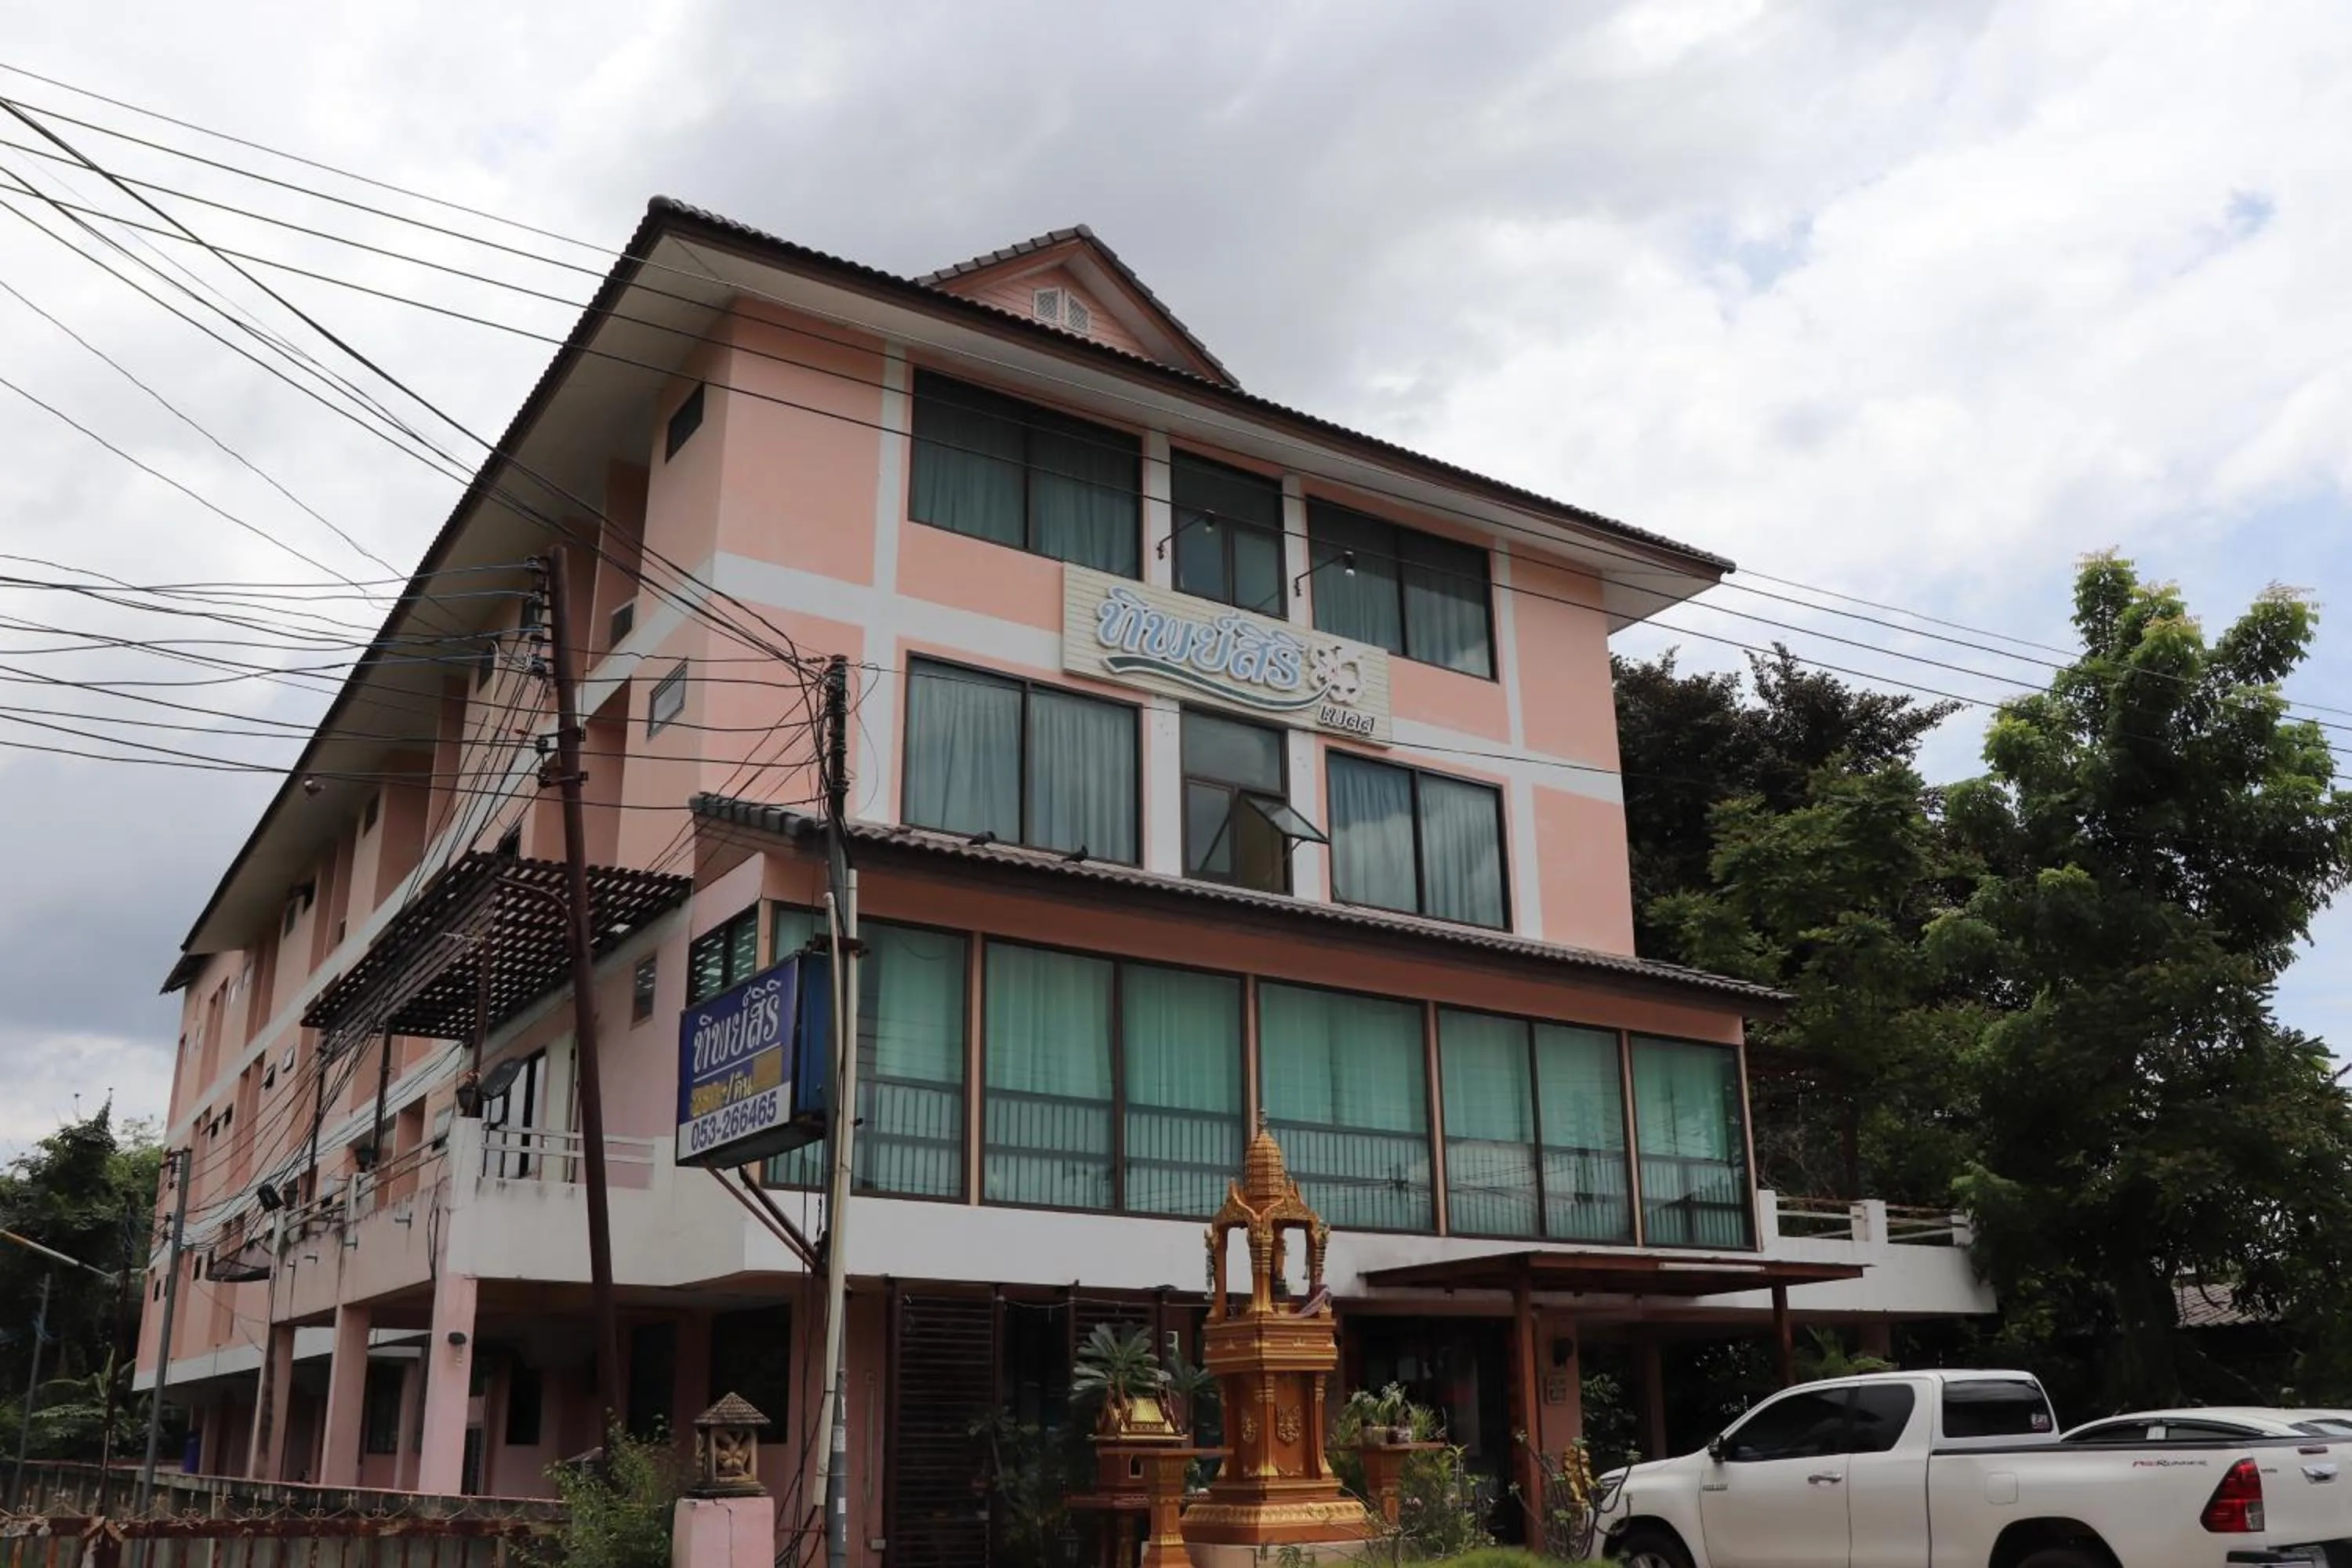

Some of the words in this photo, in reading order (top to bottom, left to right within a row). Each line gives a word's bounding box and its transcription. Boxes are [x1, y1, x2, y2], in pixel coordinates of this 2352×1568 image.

[1098, 586, 1306, 690] ทิพย์สิริ
[693, 979, 781, 1073] ทิพย์สิริ
[691, 1093, 777, 1152] 053-266465
